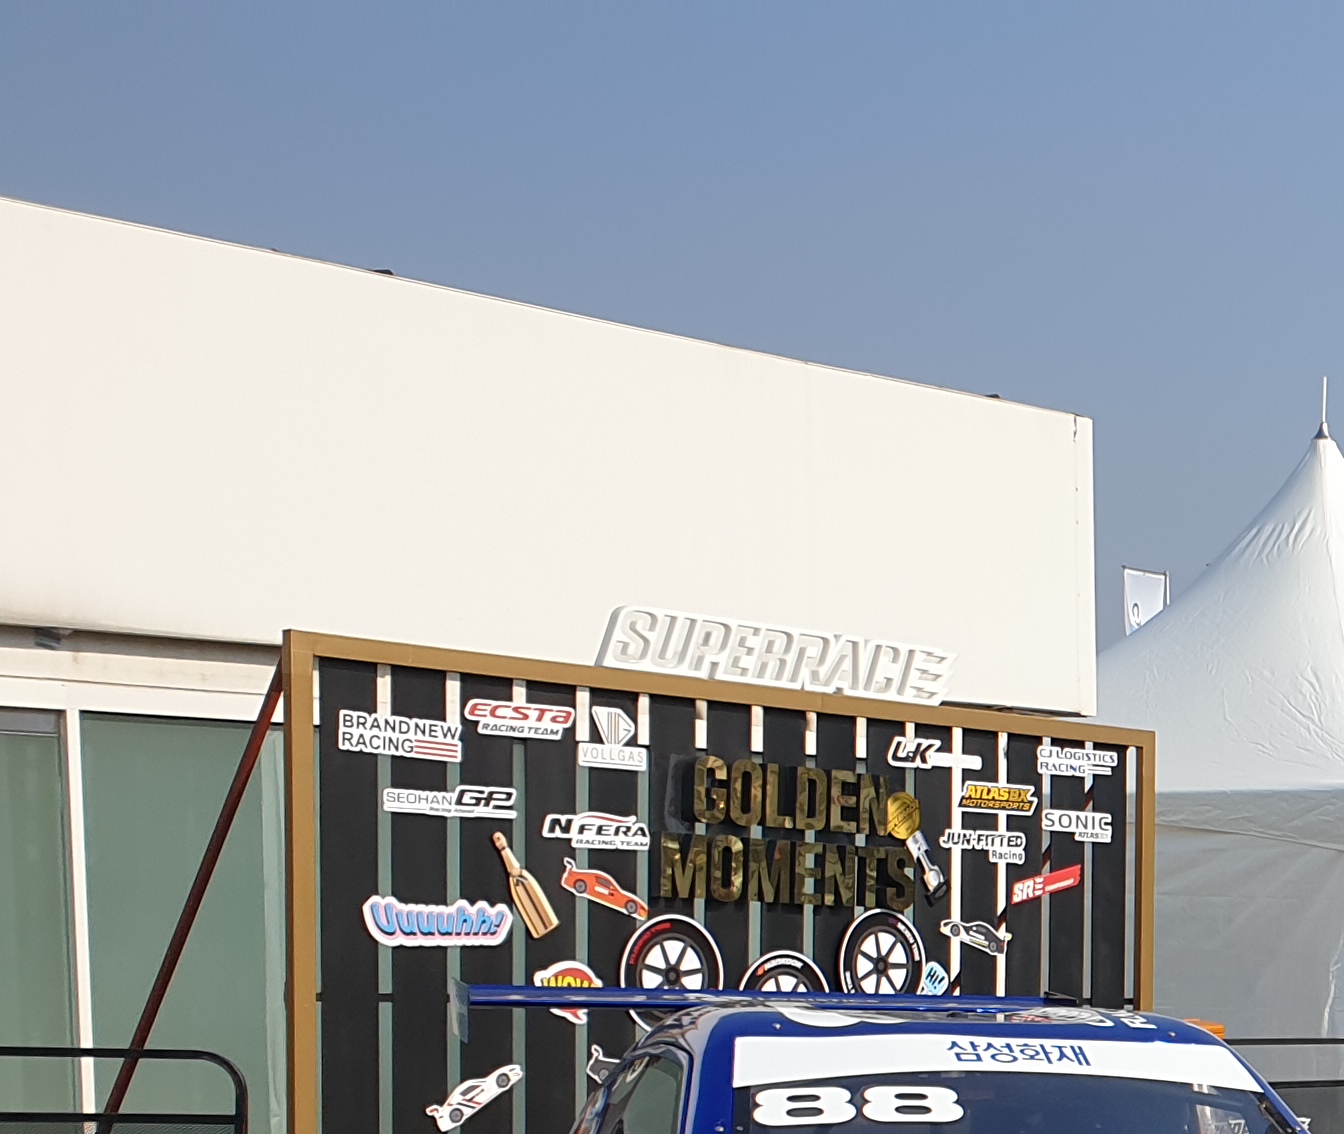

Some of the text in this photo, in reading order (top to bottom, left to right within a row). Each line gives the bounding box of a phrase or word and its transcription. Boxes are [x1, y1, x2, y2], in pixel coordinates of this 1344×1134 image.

[342, 713, 459, 741] BRAND NEW
[481, 722, 560, 737] RACING TEAM
[341, 731, 415, 754] RACING
[582, 746, 645, 764] VOLLGAS
[1039, 748, 1116, 765] CJ LOGISTICS
[1039, 762, 1087, 775] RACING
[386, 788, 514, 810] SEOHAN GP
[693, 754, 889, 837] GOLDEN
[961, 799, 1031, 811] MOTORSPORTS
[1044, 812, 1112, 832] SONIC
[575, 837, 649, 847] RACING TEAM
[942, 831, 1024, 848] JUN-FITTED
[991, 850, 1024, 862] Racing
[660, 830, 916, 912] MOMENTS
[947, 1040, 1092, 1067] 삼성화재
[752, 1085, 965, 1127] 88
